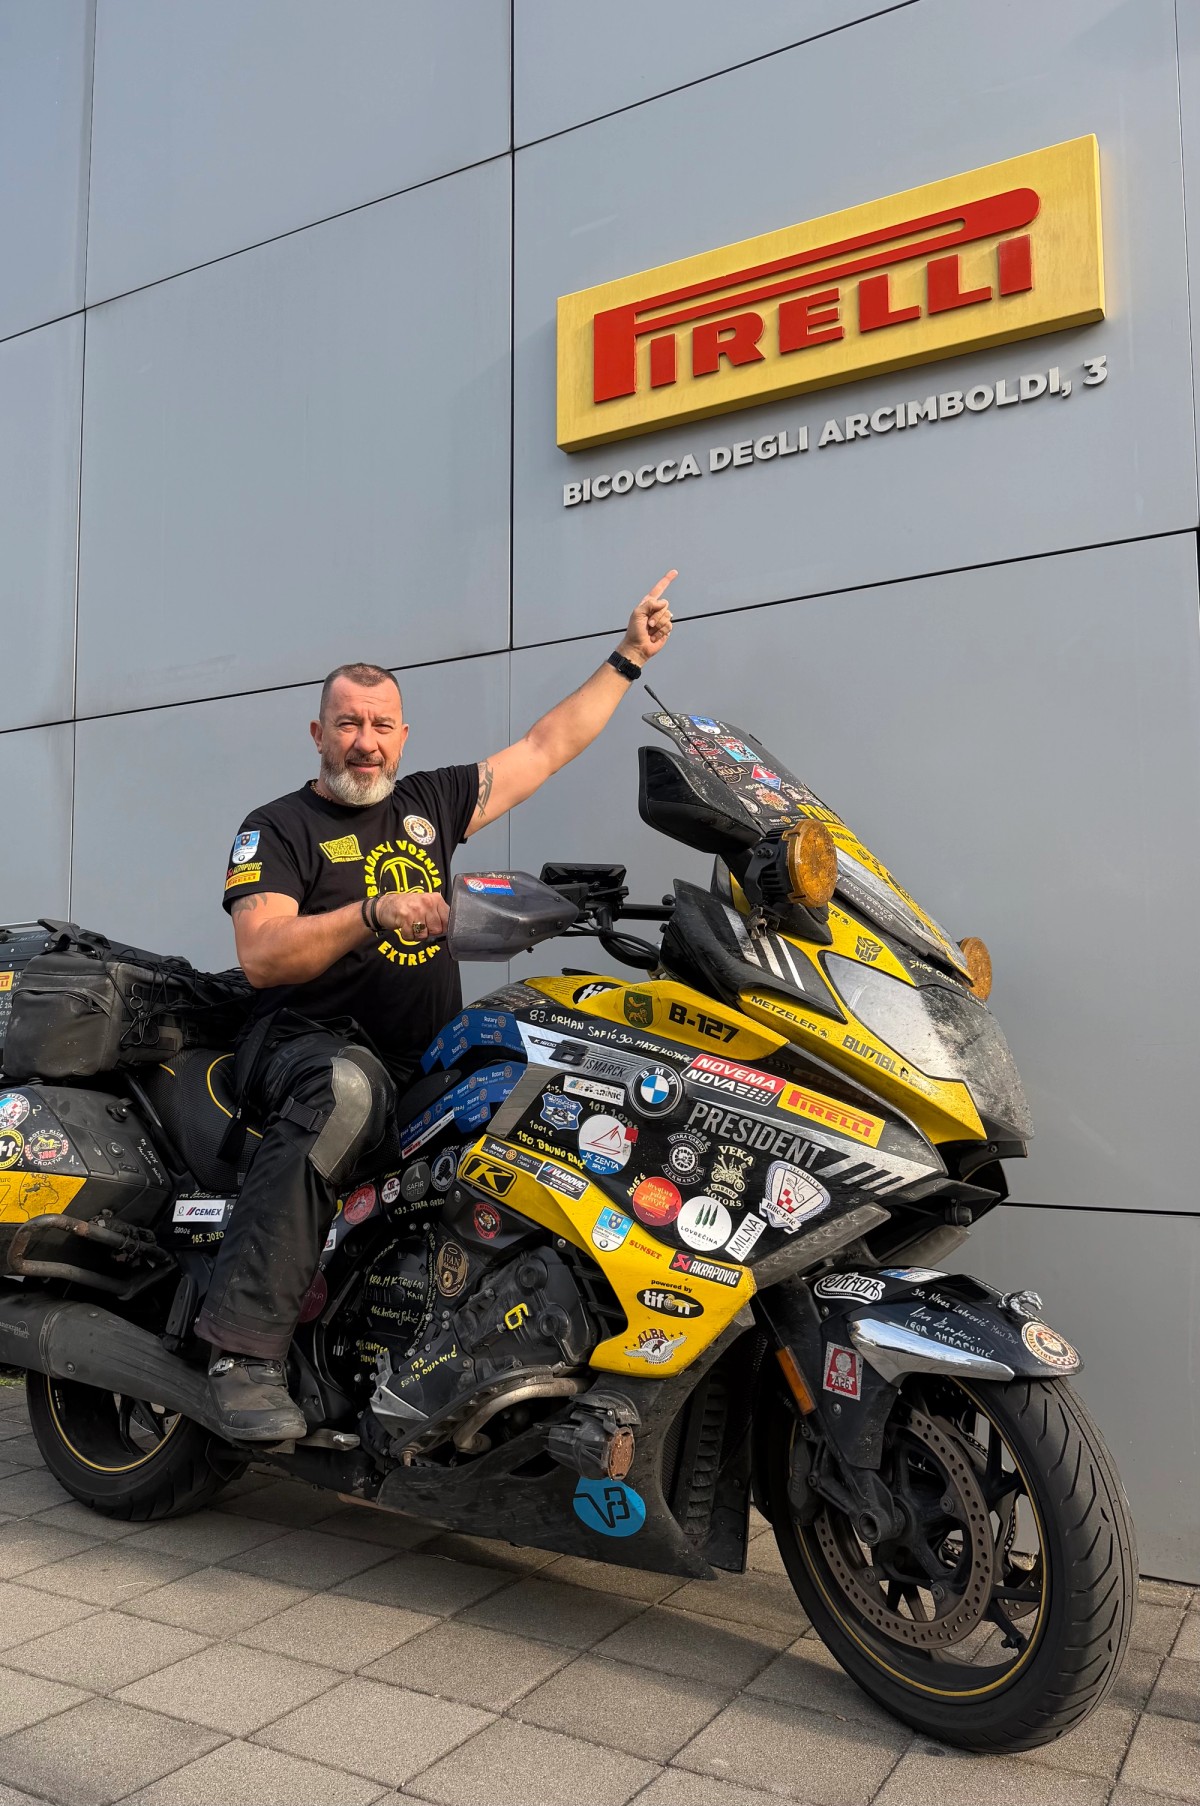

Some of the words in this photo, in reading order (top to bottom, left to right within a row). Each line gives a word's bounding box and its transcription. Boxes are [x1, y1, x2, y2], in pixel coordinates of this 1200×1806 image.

[594, 187, 1041, 403] PIRELLI
[562, 453, 701, 507] BICOCCA
[708, 425, 810, 472] DEGLI
[818, 366, 1072, 449] ARCIMBOLDI,
[1082, 354, 1109, 387] 3
[669, 1002, 740, 1044] B-127
[751, 995, 818, 1033] METZELER
[686, 1069, 736, 1092] NOVA
[697, 1058, 777, 1090] NOVEMA
[787, 1089, 875, 1137] PIRELLI
[687, 1103, 826, 1170] PRESIDENT
[490, 1143, 506, 1155] Rotary
[717, 1145, 754, 1167] VEKA
[593, 1152, 620, 1171] ZENTA
[789, 1165, 822, 1190] SECURITY
[703, 1186, 742, 1207] MOTORS
[711, 1184, 737, 1198] GARAGE
[194, 1208, 223, 1217] CEMEX
[680, 1225, 718, 1246] LOVREČINA
[729, 1219, 760, 1255] MILNA
[629, 1239, 662, 1260] SUNSET
[651, 1279, 682, 1290] powered
[683, 1284, 693, 1294] by
[643, 1289, 699, 1316] tifon
[637, 1328, 669, 1348] ALBA
